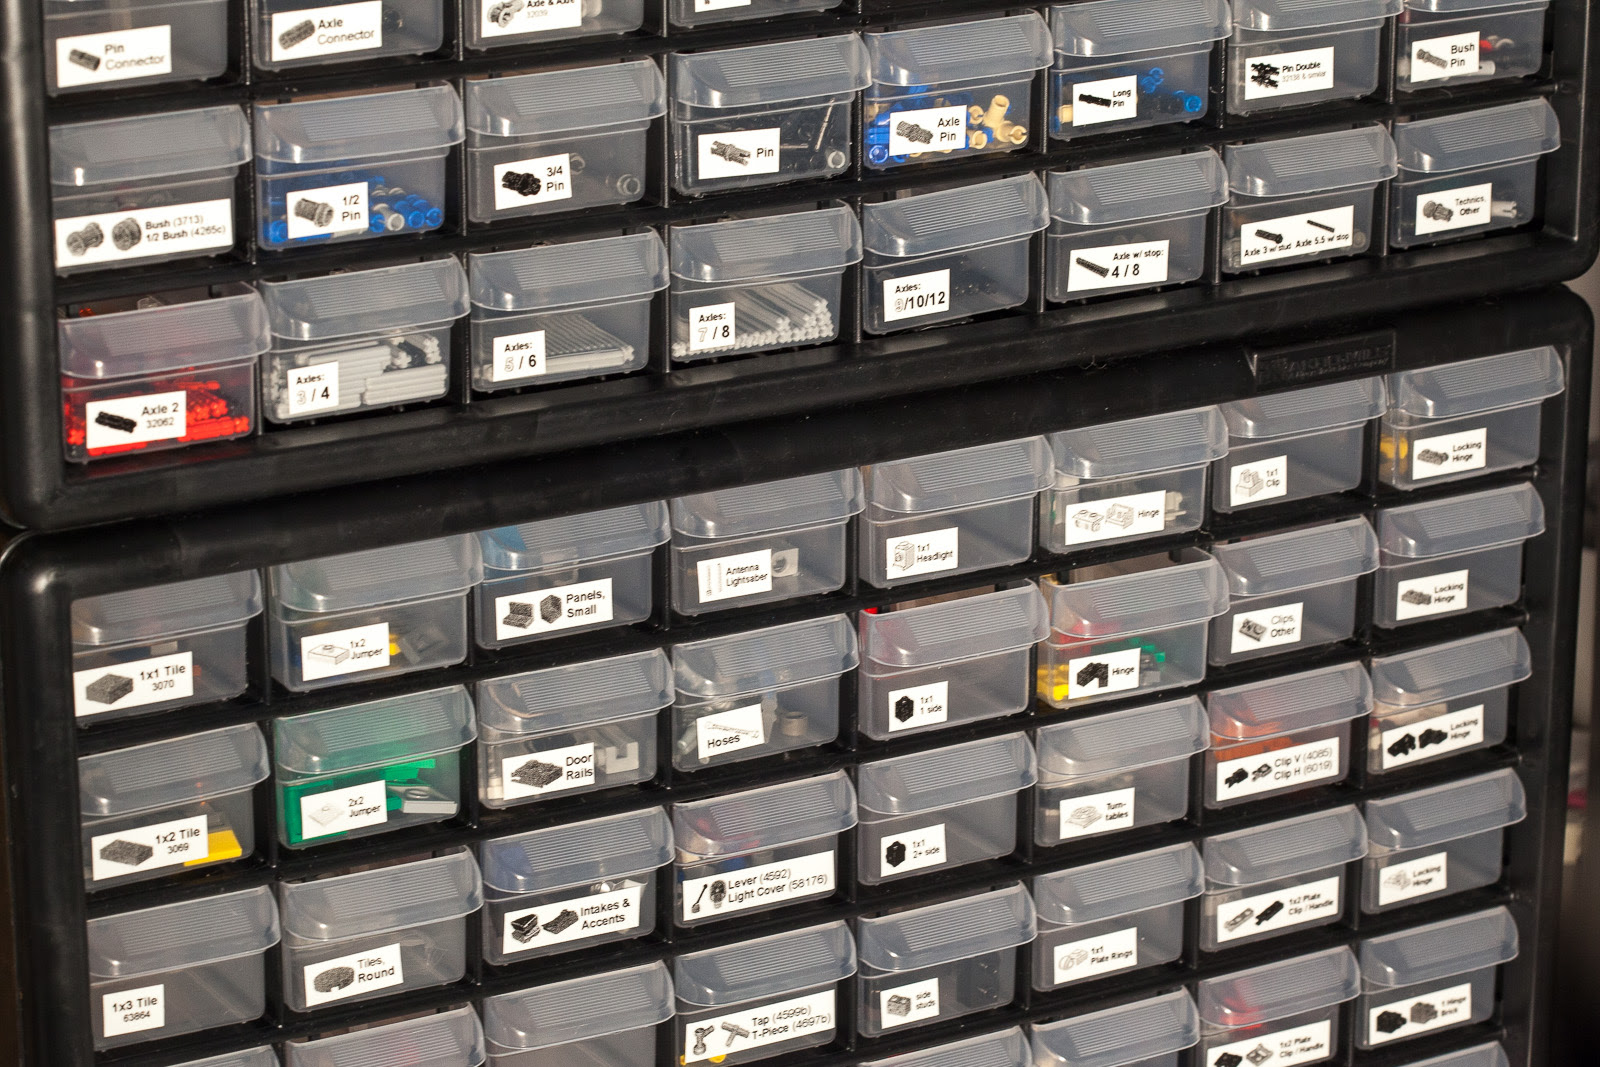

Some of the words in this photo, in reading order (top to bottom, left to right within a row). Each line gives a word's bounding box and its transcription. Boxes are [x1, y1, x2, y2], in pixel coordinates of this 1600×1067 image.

[318, 19, 343, 29] Axle
[318, 30, 374, 45] Connector
[105, 44, 124, 54] Pin
[1451, 43, 1475, 54] Bush
[106, 55, 164, 70] Connector
[1296, 61, 1320, 71] Double
[1451, 58, 1465, 67] Pin
[1112, 90, 1131, 99] Long
[938, 117, 960, 127] Axle
[940, 131, 956, 141] Pin
[757, 148, 774, 158] Pin
[547, 166, 563, 176] 3/4
[547, 181, 564, 191] Pin
[343, 195, 359, 205] 1/2
[342, 210, 360, 221] Pin
[1460, 206, 1479, 216] Other
[146, 220, 170, 230] Bush
[173, 215, 203, 227] (3713)
[147, 232, 159, 241] 1/2
[163, 230, 188, 240] Bush
[1295, 239, 1312, 248] Axle
[1314, 237, 1325, 246] 5.5
[1337, 233, 1349, 242] stop
[1244, 248, 1260, 257] Axle
[1278, 243, 1291, 251] stud
[1113, 252, 1130, 261] Axle
[1112, 266, 1119, 277] 4
[1133, 264, 1139, 276] 8
[895, 284, 921, 293] Axles:
[699, 313, 726, 323] Axles:
[698, 328, 708, 343] 7
[722, 326, 730, 338] 8
[505, 342, 532, 352] Axles:
[505, 357, 514, 371] 5
[529, 355, 536, 367] 6
[296, 374, 324, 385] Axles:
[321, 387, 330, 399] 4
[142, 405, 167, 416] Axle
[171, 402, 179, 412] 2
[146, 418, 174, 429] 32062
[1453, 442, 1482, 452] Locking
[1453, 453, 1473, 462] Hinge
[1266, 469, 1278, 477] 1x1
[1266, 479, 1279, 488] Clip
[1138, 509, 1159, 518] Hinge
[917, 543, 930, 552] 1x1
[917, 550, 953, 562] Headlight
[726, 564, 759, 575] Antenna
[726, 573, 768, 587] Lightsaber
[1435, 583, 1464, 593] Locking
[567, 590, 605, 603] Panels,
[1434, 595, 1455, 604] Hinge
[567, 605, 596, 618] Small
[1271, 626, 1294, 638] Other
[350, 639, 366, 648] 1x2
[351, 647, 383, 660] Jumper
[141, 670, 159, 680] 1x1
[164, 664, 185, 675] Tile
[1112, 666, 1135, 676] Hinge
[152, 680, 174, 691] 3070
[927, 704, 942, 714] side
[1451, 719, 1478, 731] Locking
[1451, 731, 1470, 740] Hinge
[707, 735, 740, 749] Hoses
[566, 754, 592, 766] Door
[1274, 757, 1292, 768] Clip
[1294, 755, 1300, 763] V
[566, 769, 593, 781] Rails
[1274, 770, 1290, 780] Clip
[349, 797, 364, 807] 2x2
[349, 805, 381, 818] Jumper
[1106, 811, 1128, 820] tables
[156, 832, 176, 844] 1x2
[180, 828, 200, 838] Tile
[168, 843, 188, 854] 3069
[913, 840, 925, 848] 1x1
[925, 846, 940, 855] side
[729, 877, 757, 890] Lever
[759, 869, 791, 885] (4592)
[728, 890, 754, 903] Light
[757, 883, 785, 896] Cover
[789, 874, 828, 891] (58176)
[581, 901, 619, 916] Intakes
[581, 914, 625, 930] Accents
[1091, 946, 1103, 954] 1x1
[1091, 955, 1109, 964] Plate
[1111, 950, 1133, 961] Rings
[358, 966, 394, 982] Round
[916, 992, 930, 1000] side
[113, 1000, 132, 1012] 1x3
[137, 996, 157, 1007] Tile
[916, 1000, 935, 1009] studs
[123, 1011, 150, 1022] 63864
[752, 1015, 769, 1027] Tap
[772, 1005, 811, 1023] (4599b)
[752, 1025, 788, 1039] T-Piece
[792, 1013, 831, 1031] (4697b)
